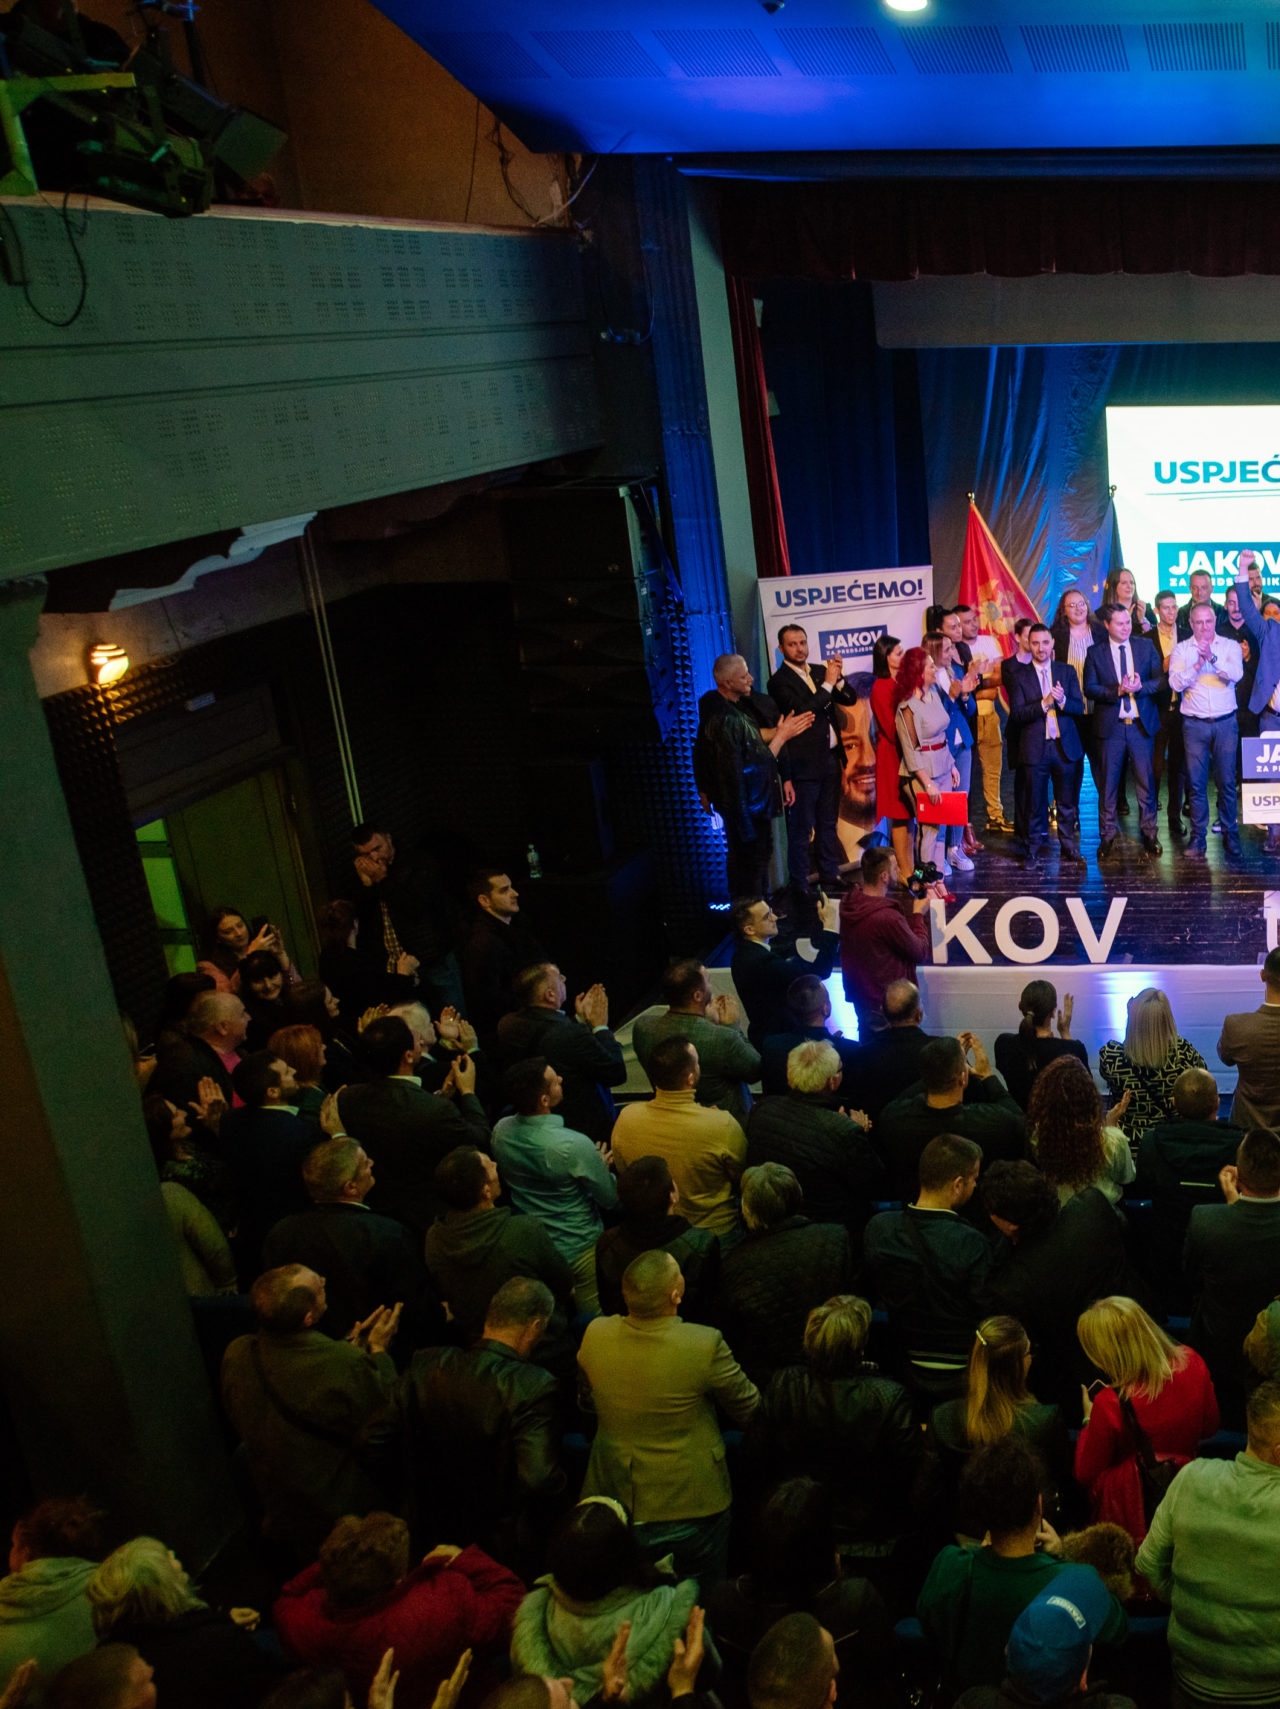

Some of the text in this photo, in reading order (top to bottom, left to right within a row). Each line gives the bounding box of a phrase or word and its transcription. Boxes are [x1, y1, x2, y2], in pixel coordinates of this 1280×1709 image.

[1169, 577, 1187, 587] ZA
[774, 578, 923, 608] USPJEĆEMO!
[825, 630, 883, 650] JAKOV
[1256, 765, 1269, 773] ZA
